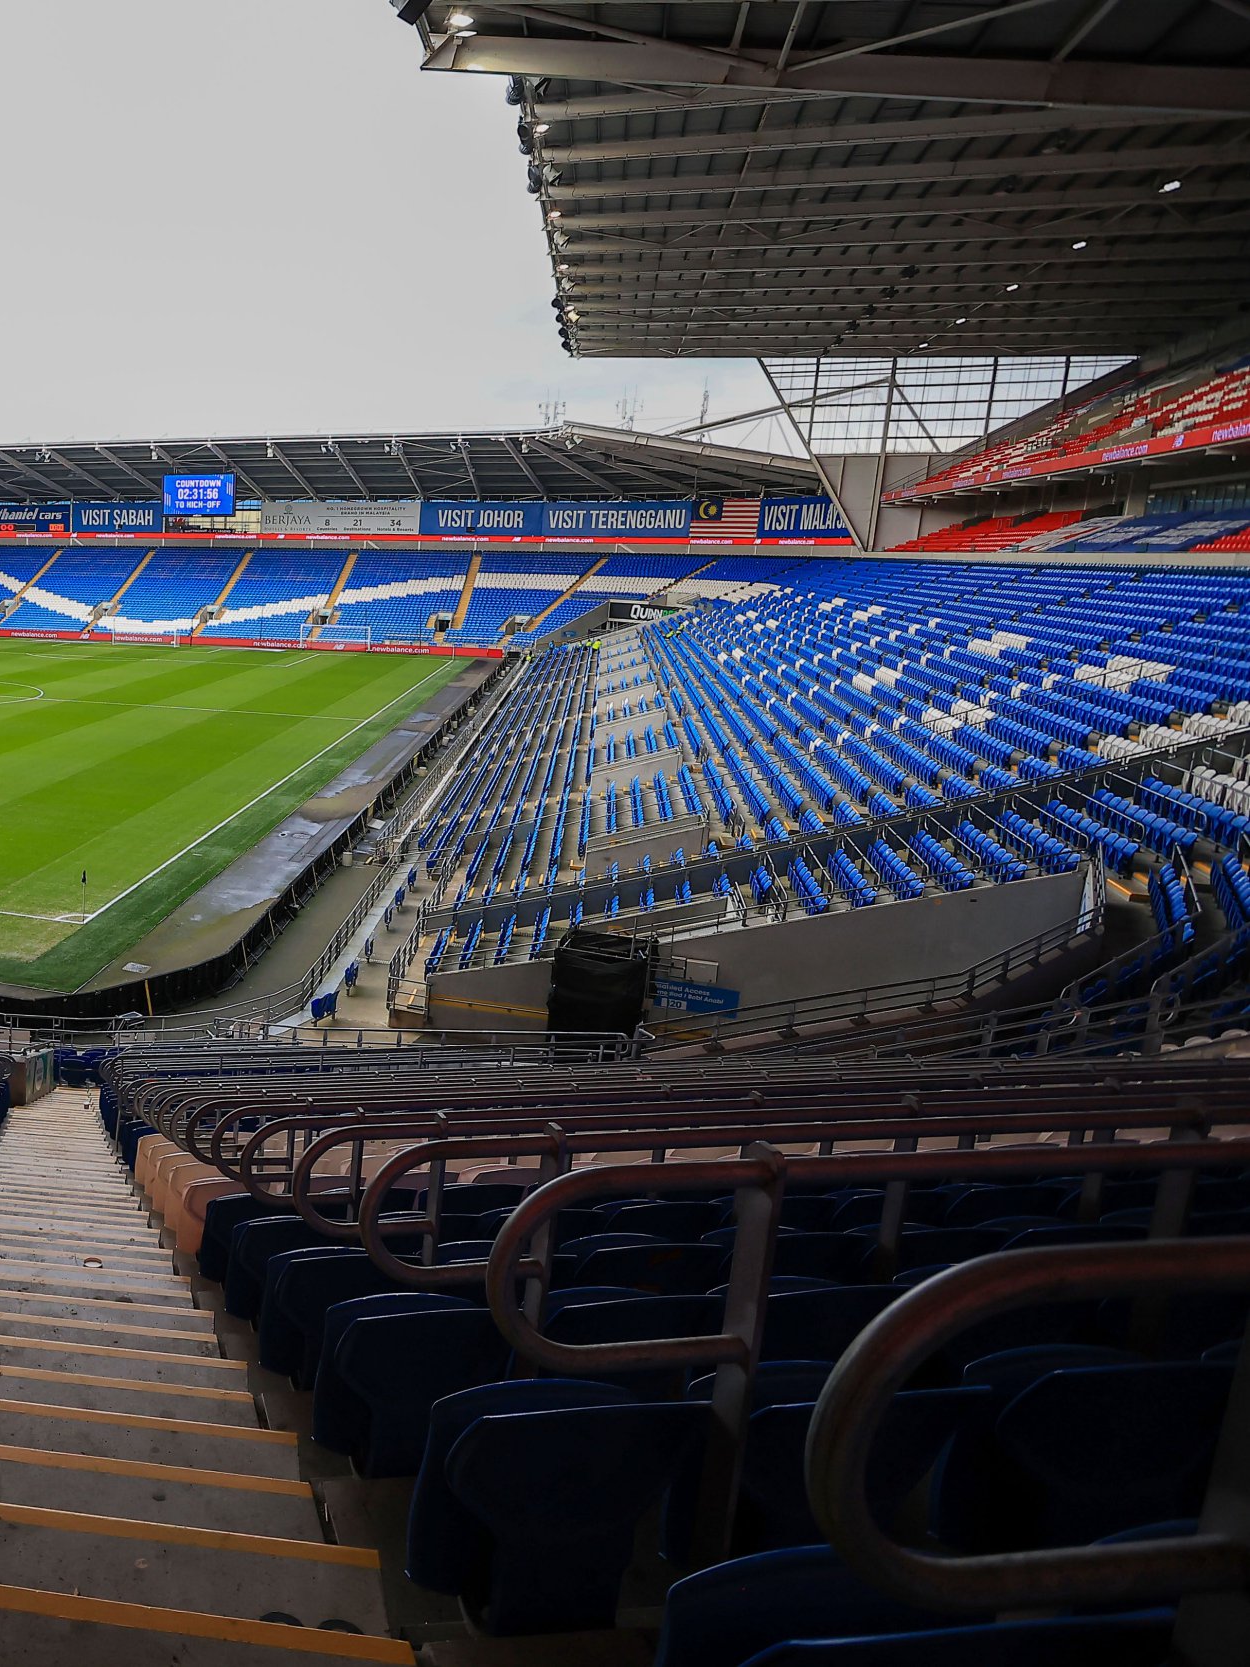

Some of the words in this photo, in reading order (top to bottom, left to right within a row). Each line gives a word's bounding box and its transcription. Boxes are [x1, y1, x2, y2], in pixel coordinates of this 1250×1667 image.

[1211, 421, 1250, 442] newbalan
[1102, 445, 1148, 461] newbalance.com
[177, 489, 218, 499] 02:31:56
[39, 512, 62, 520] cars
[81, 509, 110, 525] VISIT
[113, 509, 153, 525] SABAH
[265, 515, 311, 526] BERJAYA
[438, 509, 475, 527] VISIT
[477, 510, 524, 528] JOHOR
[549, 510, 587, 528] VISIT
[590, 509, 686, 528] TERENGGANU
[764, 505, 799, 530] VISIT
[800, 503, 847, 529] MALAYS
[11, 631, 58, 639] newbalance.com
[372, 646, 430, 655] newbalance.com
[684, 986, 711, 996] Access
